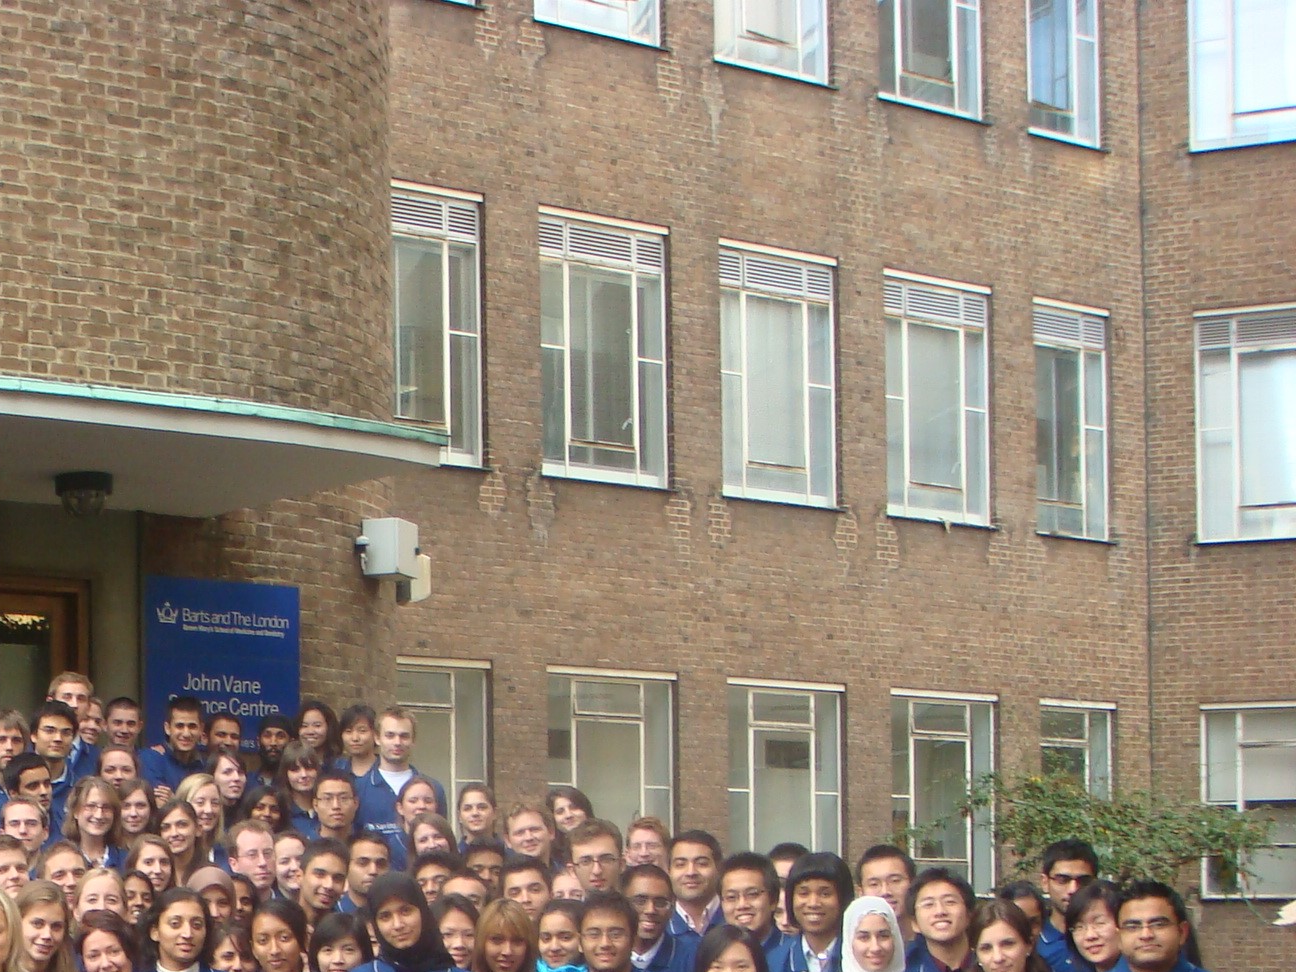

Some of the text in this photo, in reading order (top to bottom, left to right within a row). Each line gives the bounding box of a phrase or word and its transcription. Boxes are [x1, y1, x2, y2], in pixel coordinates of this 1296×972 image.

[183, 608, 290, 629] Barts and The London
[183, 673, 261, 694] John Vane
[229, 698, 279, 717] Centre
